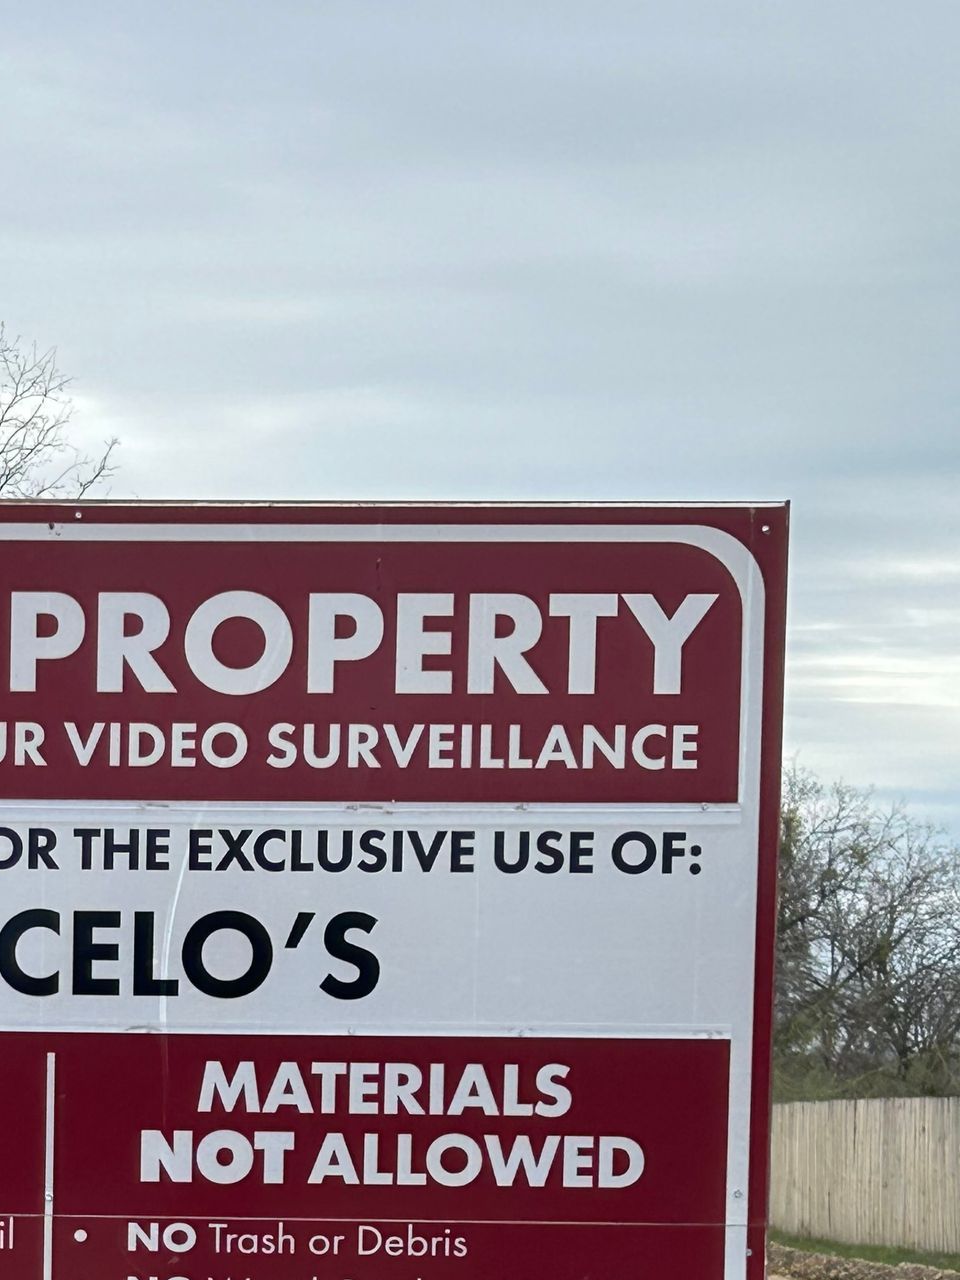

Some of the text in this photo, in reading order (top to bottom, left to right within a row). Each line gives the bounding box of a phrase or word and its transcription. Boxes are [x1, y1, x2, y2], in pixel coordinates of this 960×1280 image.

[9, 590, 720, 696] PROPERTY
[63, 721, 248, 769] VIDEO
[266, 722, 699, 771] SURVEILLANCE
[73, 828, 171, 871] THE
[188, 828, 476, 874] EXCLUSIVE
[493, 830, 595, 875] USE
[611, 830, 702, 876] OF:
[197, 1060, 572, 1118] MATERIALS
[139, 1129, 645, 1189] NOT ALLOWED
[127, 1221, 468, 1258] NO Trash or Debris
